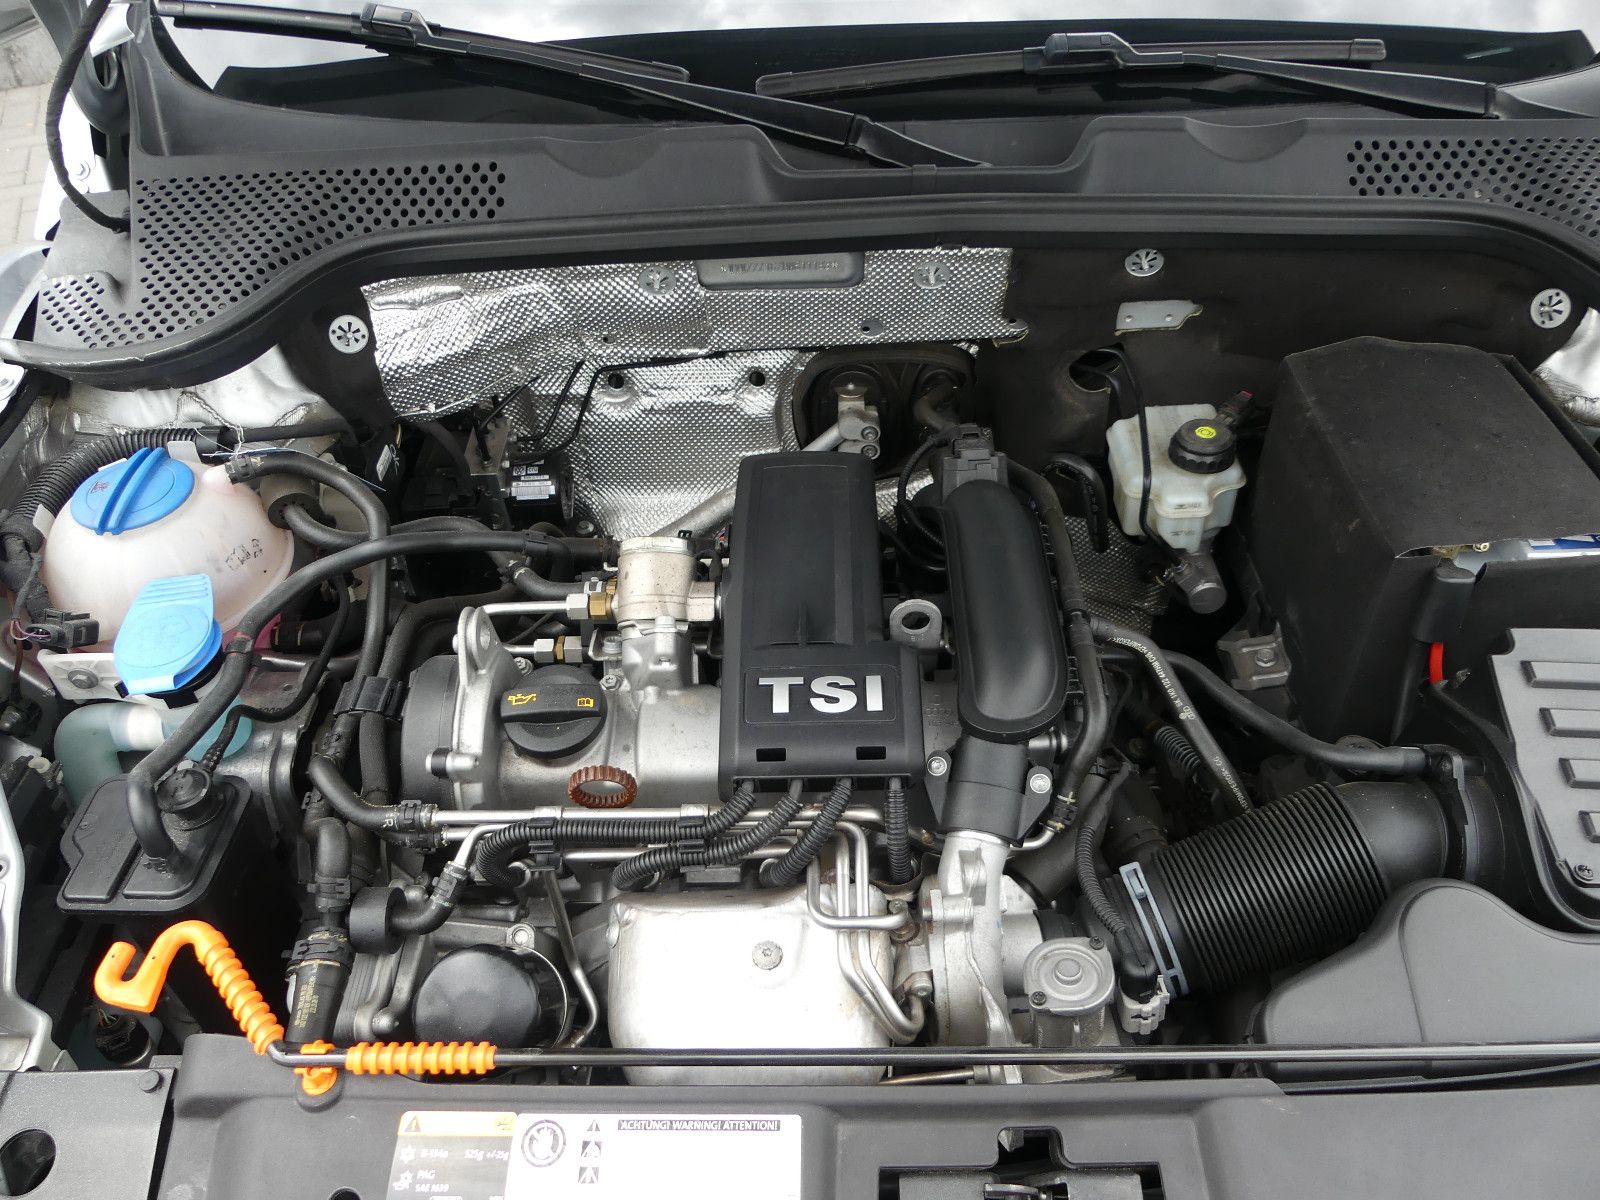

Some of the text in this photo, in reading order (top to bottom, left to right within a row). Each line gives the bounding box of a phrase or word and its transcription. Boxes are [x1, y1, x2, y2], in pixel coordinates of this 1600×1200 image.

[758, 675, 883, 713] TSI
[621, 1120, 778, 1131] ACHTUNG! WARNING! ATTENTION!
[417, 1169, 436, 1180] PAG
